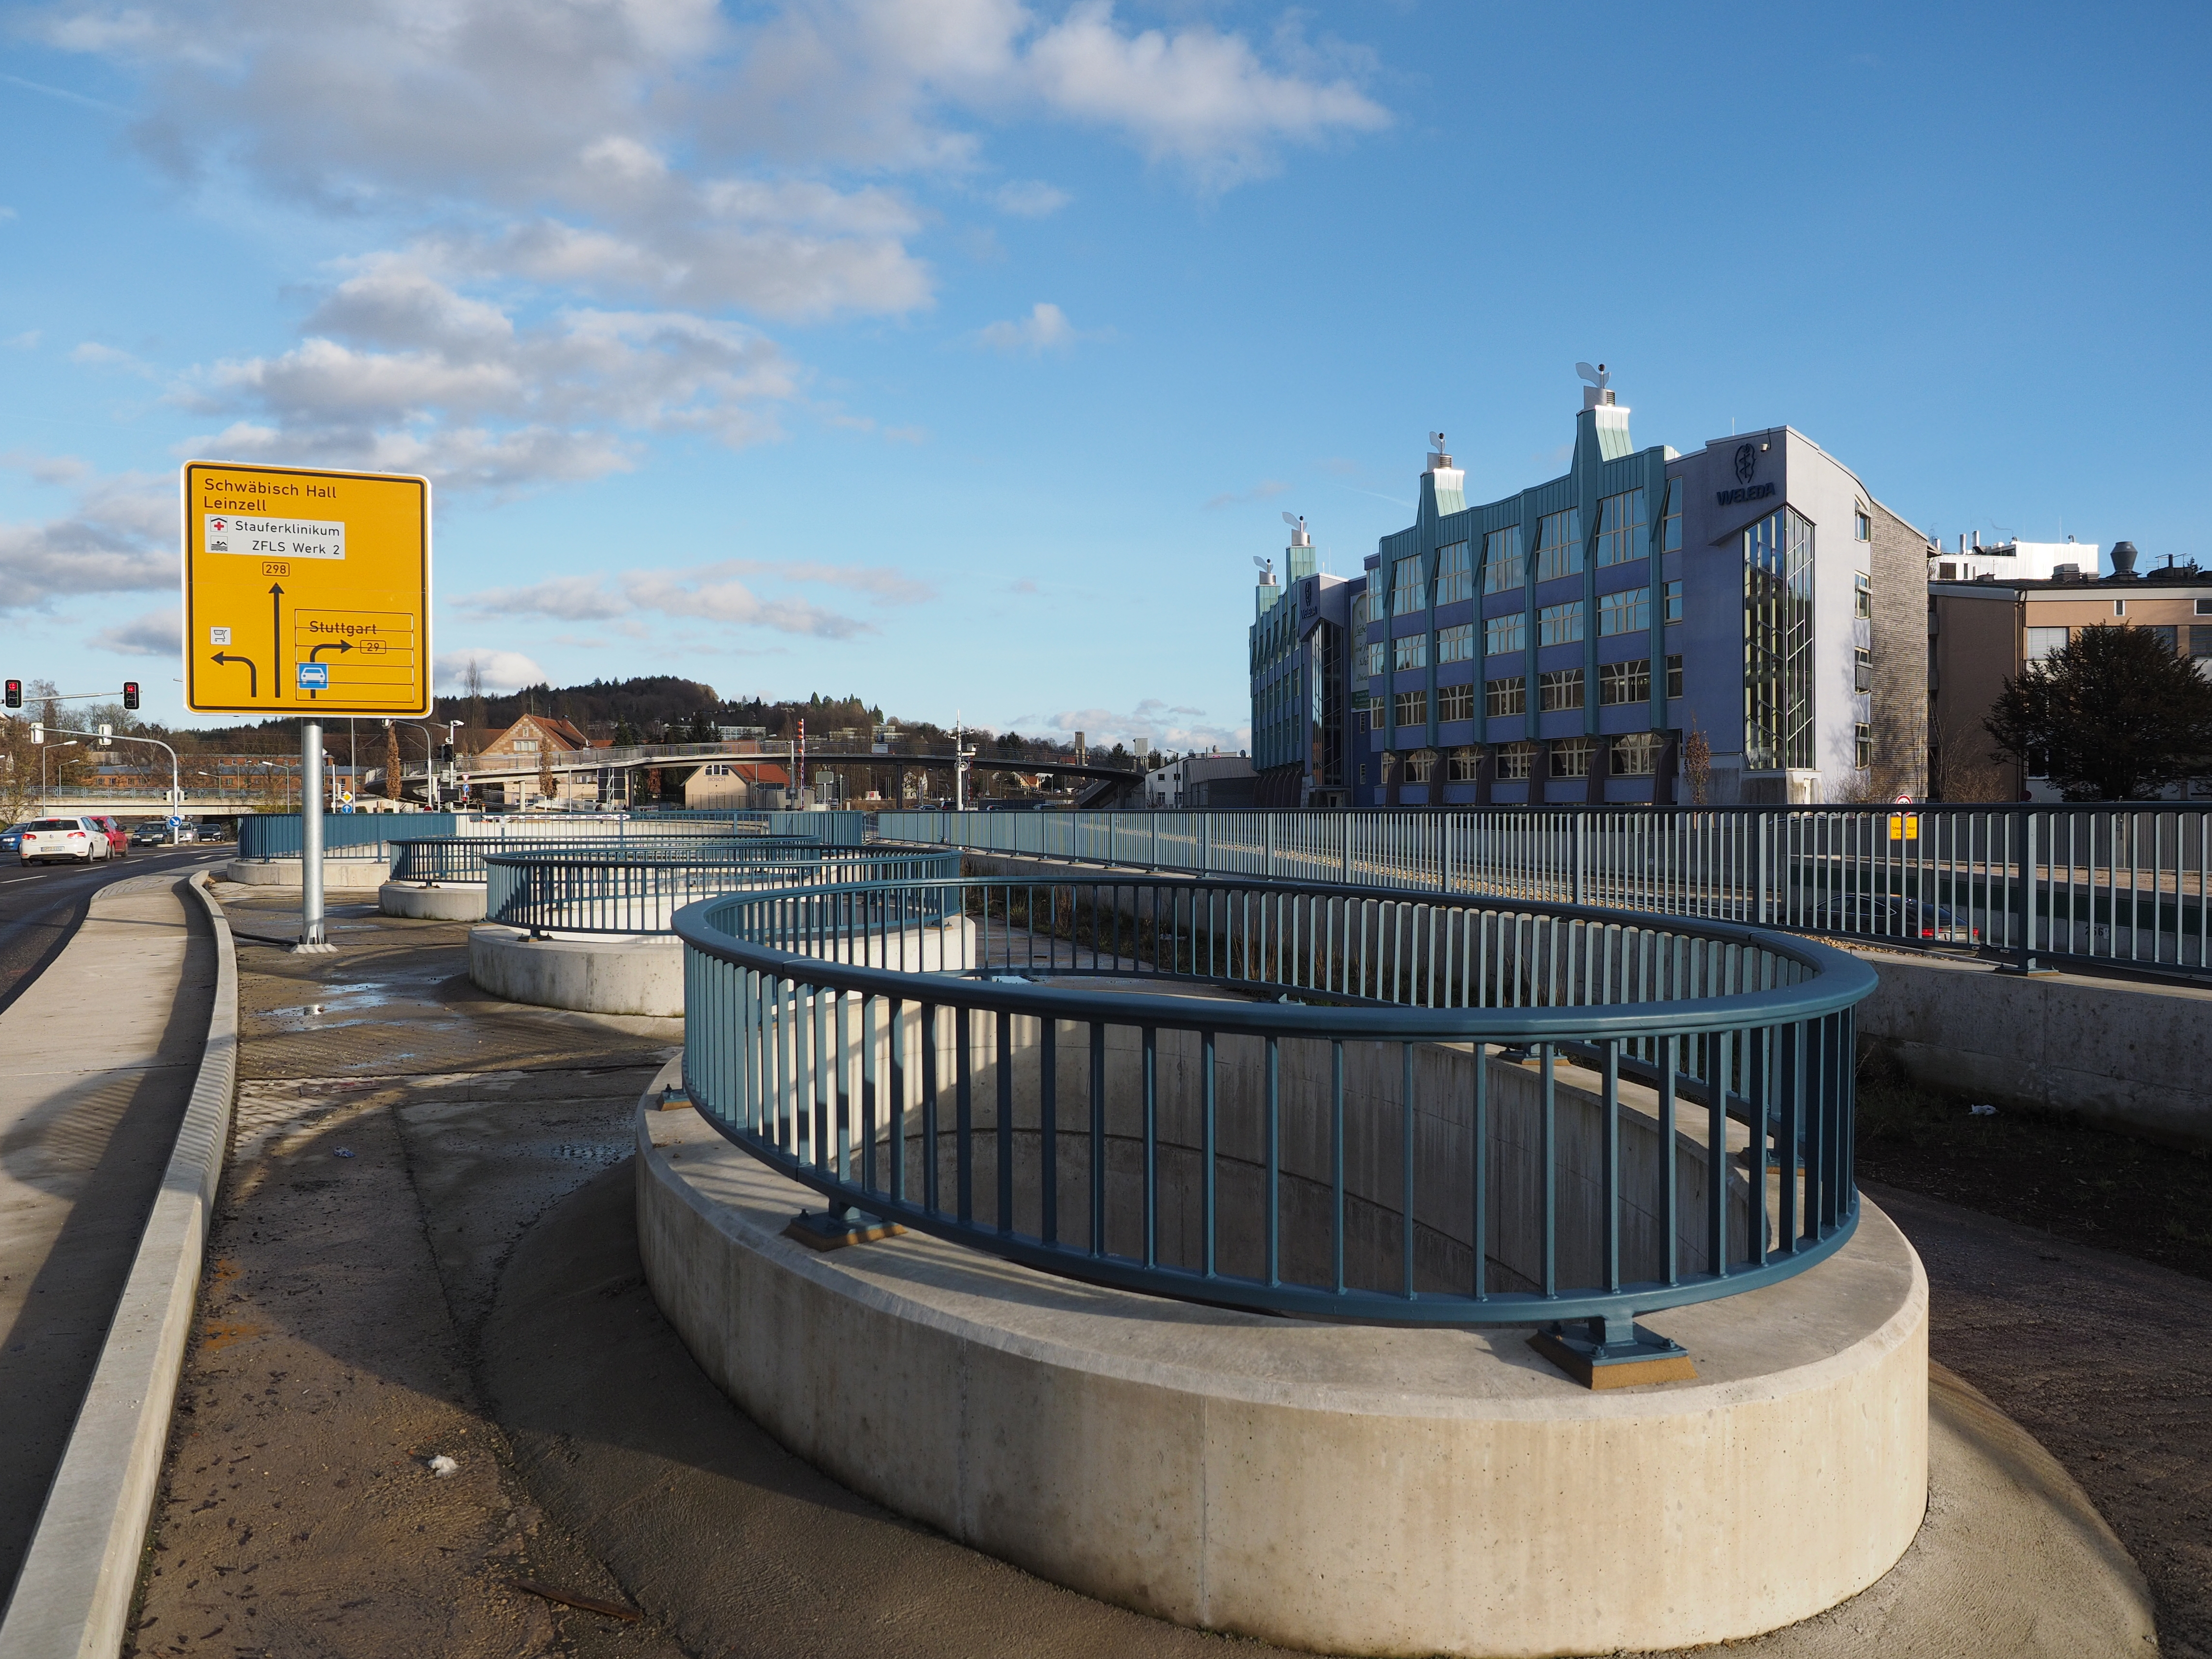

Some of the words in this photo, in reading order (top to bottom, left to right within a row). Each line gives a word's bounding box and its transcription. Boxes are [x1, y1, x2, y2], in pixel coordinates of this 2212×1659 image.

[204, 478, 299, 496] Schwäbisch
[307, 485, 336, 498] Hall
[1717, 482, 1776, 505] WELEDA
[204, 496, 266, 511] Leinzell
[235, 520, 339, 536] Stauferklinikum
[252, 541, 285, 552] ZFLS
[293, 542, 326, 554] Werk
[333, 545, 339, 554] 2
[265, 564, 287, 574] 298
[1300, 606, 1317, 619] WELEDA
[310, 621, 376, 637] Stuttgart
[367, 642, 379, 651] 29
